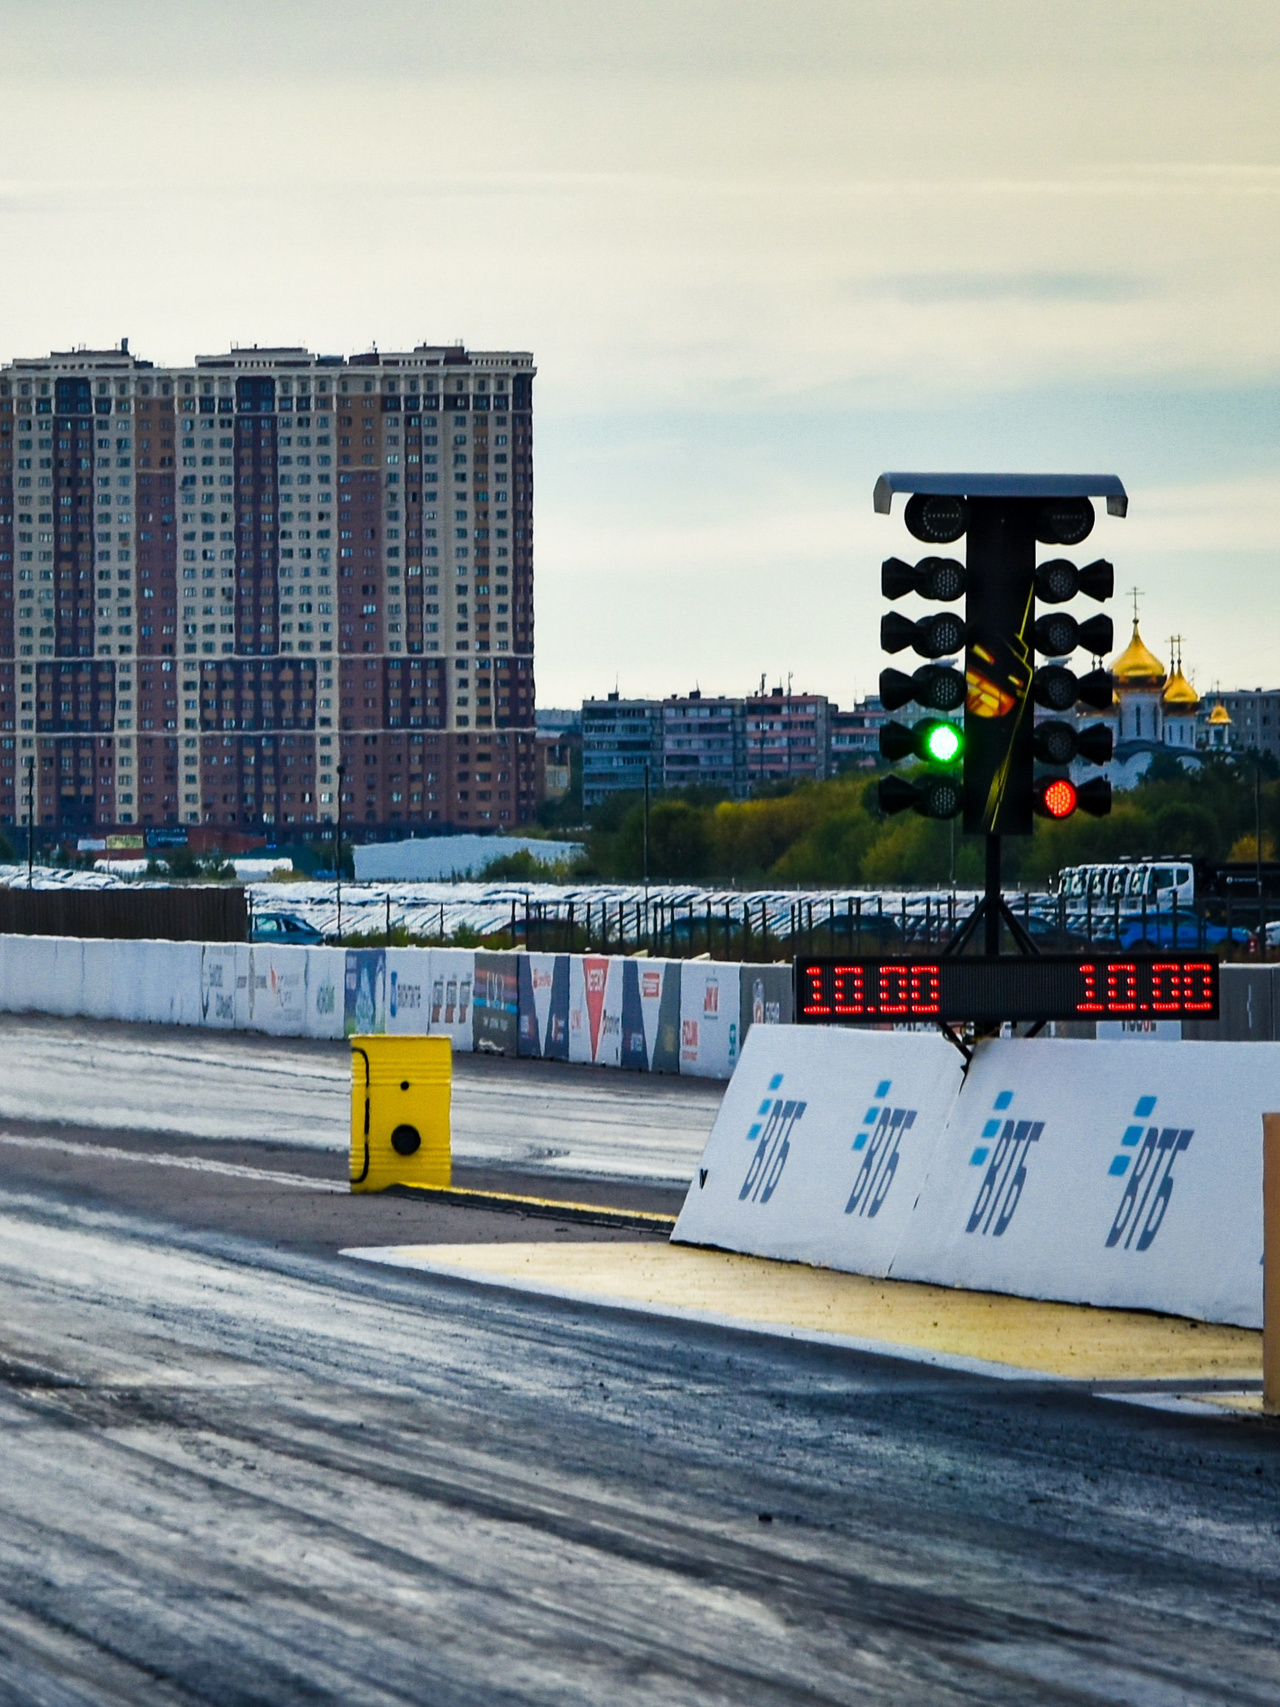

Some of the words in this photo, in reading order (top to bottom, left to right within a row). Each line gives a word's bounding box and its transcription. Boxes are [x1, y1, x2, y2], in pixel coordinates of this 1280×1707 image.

[804, 966, 939, 1014] 10.00
[1077, 964, 1211, 1011] 10.00
[739, 1100, 807, 1203] ВТБ
[845, 1108, 917, 1217] ВТБ
[965, 1120, 1045, 1236] ВТБ
[1104, 1127, 1195, 1251] ВТБ
